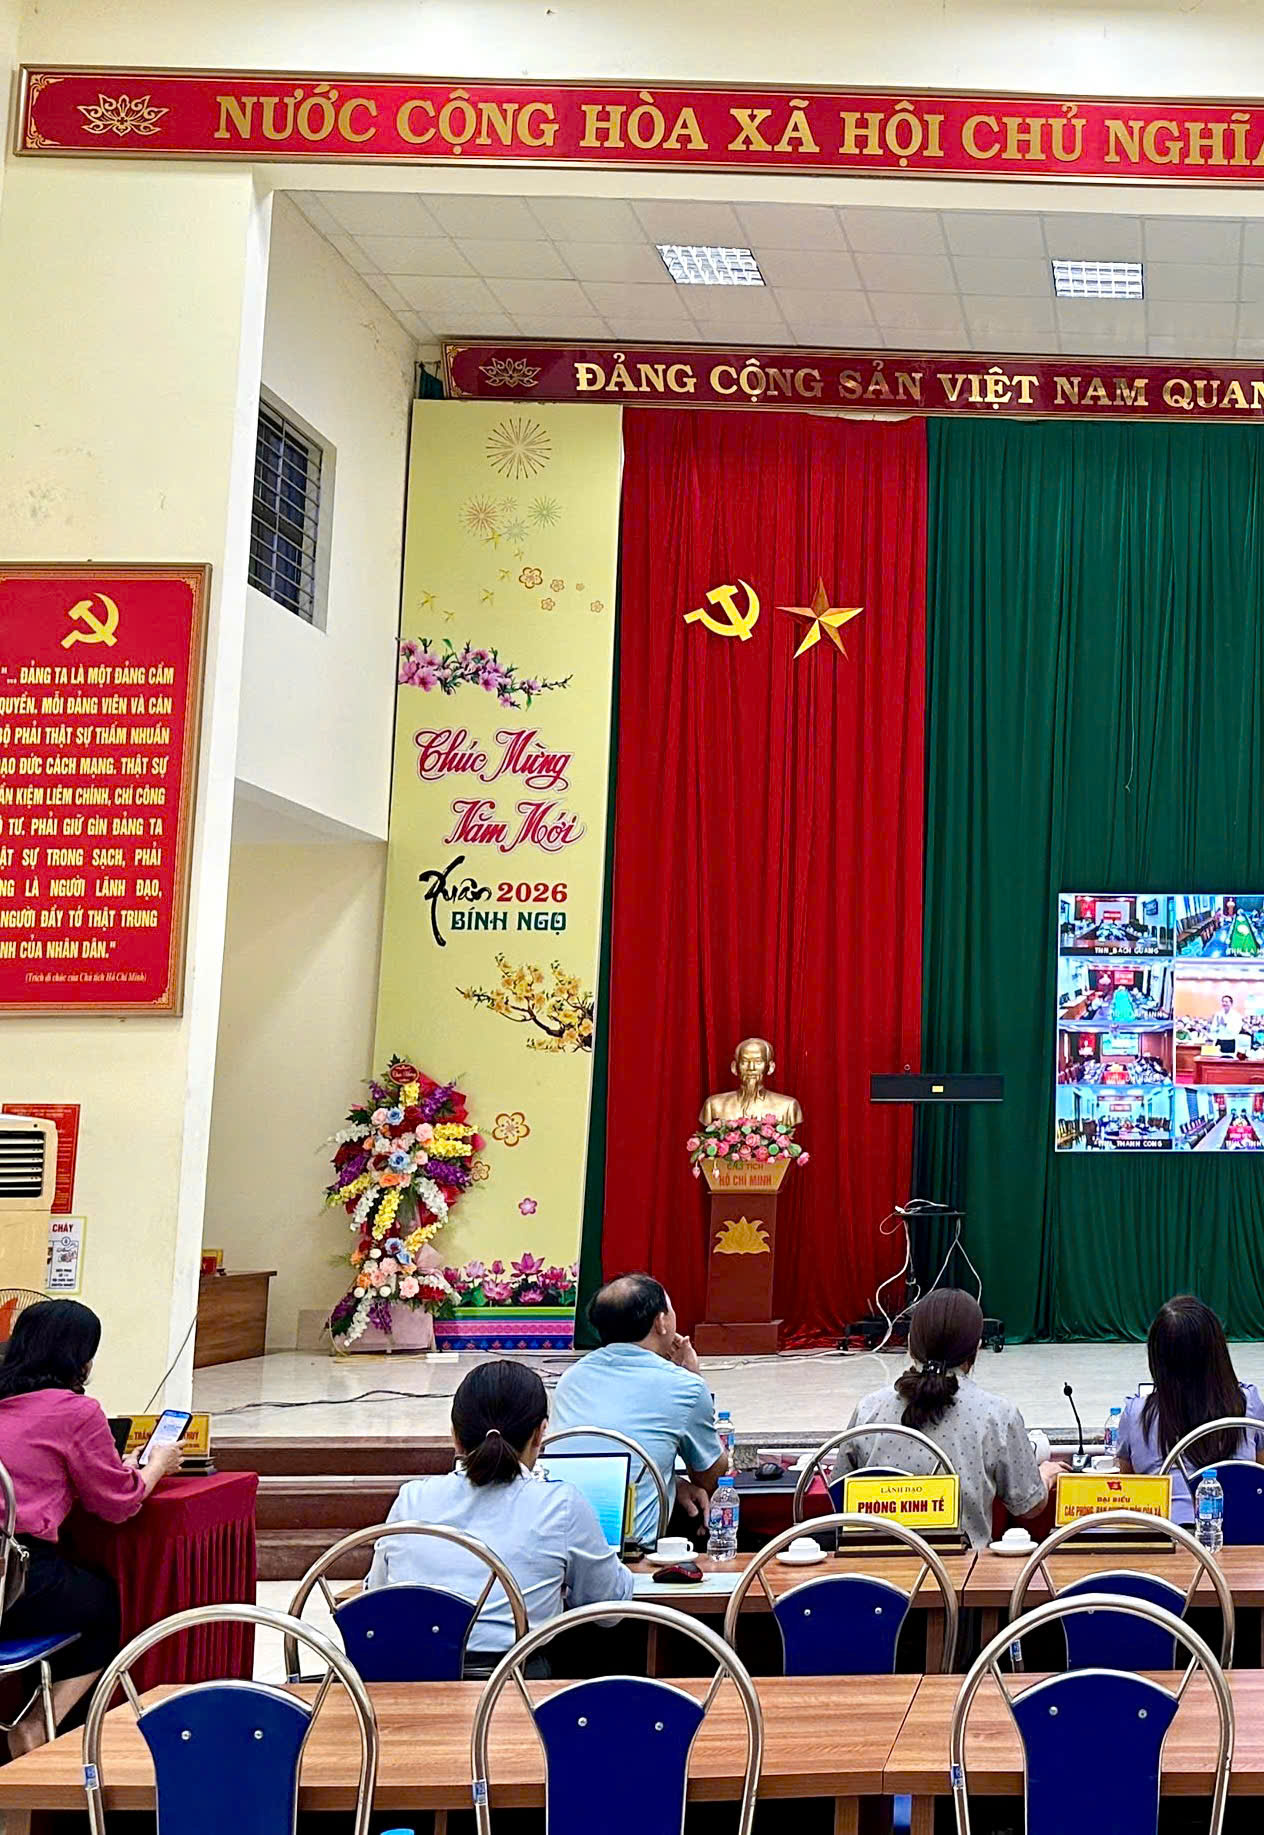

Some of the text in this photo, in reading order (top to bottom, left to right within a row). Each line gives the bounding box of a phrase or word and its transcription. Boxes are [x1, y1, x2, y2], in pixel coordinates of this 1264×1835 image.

[214, 84, 376, 142] NƯỚC
[397, 91, 559, 154] CỘNG
[580, 91, 709, 150] HÒA
[728, 100, 819, 153] XÃ
[839, 101, 944, 167] HỘI
[962, 104, 1084, 162] CHỦ
[575, 353, 696, 395] ĐẢNG
[710, 358, 823, 402] CỘNG
[838, 360, 922, 400] SẢN
[936, 367, 1040, 409] VIỆT
[1053, 376, 1149, 406] NAM
[20, 660, 145, 688] ĐẢNG TA LÀ MỘT ĐẢNG
[67, 690, 98, 714] ĐẢNG
[101, 694, 127, 714] VIÊN
[131, 694, 145, 714] VÀ
[14, 720, 93, 748] PHẢI THẬT SỰ
[19, 753, 169, 778] ĐỨC CÁCH MẠNG. THẬT SỰ
[415, 729, 571, 791] Chúc Mừng
[16, 784, 165, 808] KIỆM LIÊM CHÍNH, CHÍ CÔNG
[8, 816, 25, 835] TƯ.
[31, 811, 58, 835] PHẢI
[63, 814, 84, 835] GIỮ
[87, 814, 108, 835] GÌN
[112, 811, 144, 835] ĐẢNG
[150, 819, 163, 835] TA
[444, 799, 583, 854] Năm Mới
[22, 842, 162, 870] SỰ TRONG SẠCH, PHẢI
[25, 875, 162, 900] LÀ NGƯỜI LÃNH ĐẠO,
[419, 856, 567, 947] Xuân 2026
[68, 905, 84, 927] TỚ
[88, 907, 115, 931] THẬT
[120, 910, 158, 927] TRUNG
[451, 907, 567, 936] BÍNH NGỌ
[20, 934, 42, 958] CỦA
[46, 937, 79, 958] NHÂN
[858, 1495, 945, 1514] PHÒNG KINH TẾ
